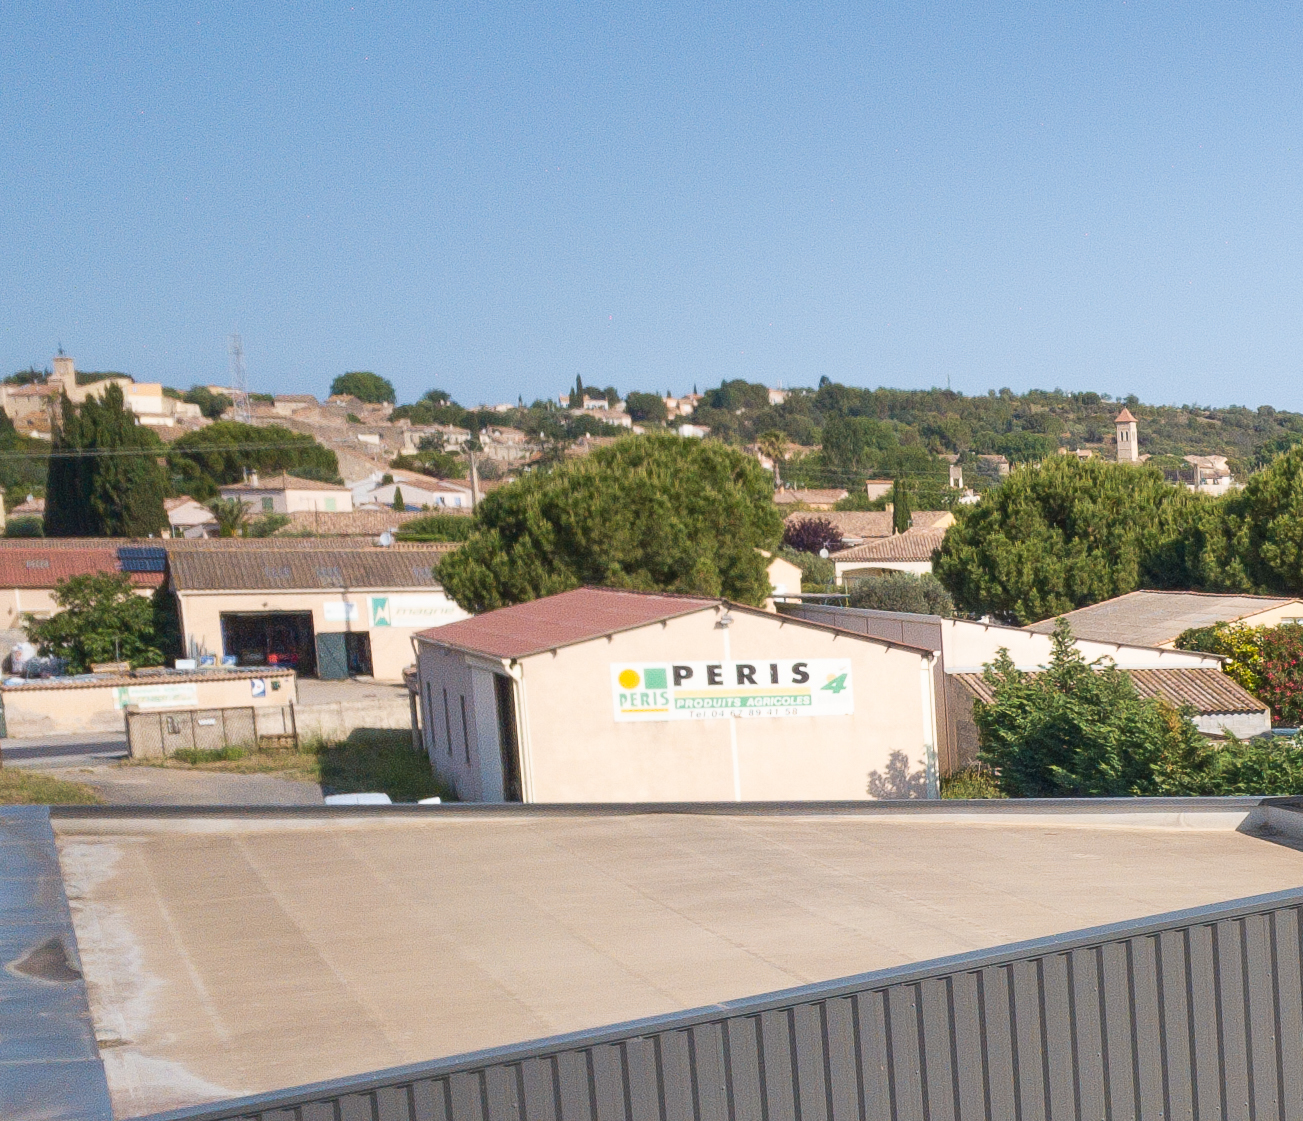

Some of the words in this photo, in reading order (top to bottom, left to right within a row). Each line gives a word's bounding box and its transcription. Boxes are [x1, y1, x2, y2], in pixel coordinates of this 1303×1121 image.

[672, 662, 810, 686] PERIS
[619, 691, 669, 708] PERIS
[675, 698, 741, 709] PRODUITS
[746, 695, 811, 707] AGRICOLES
